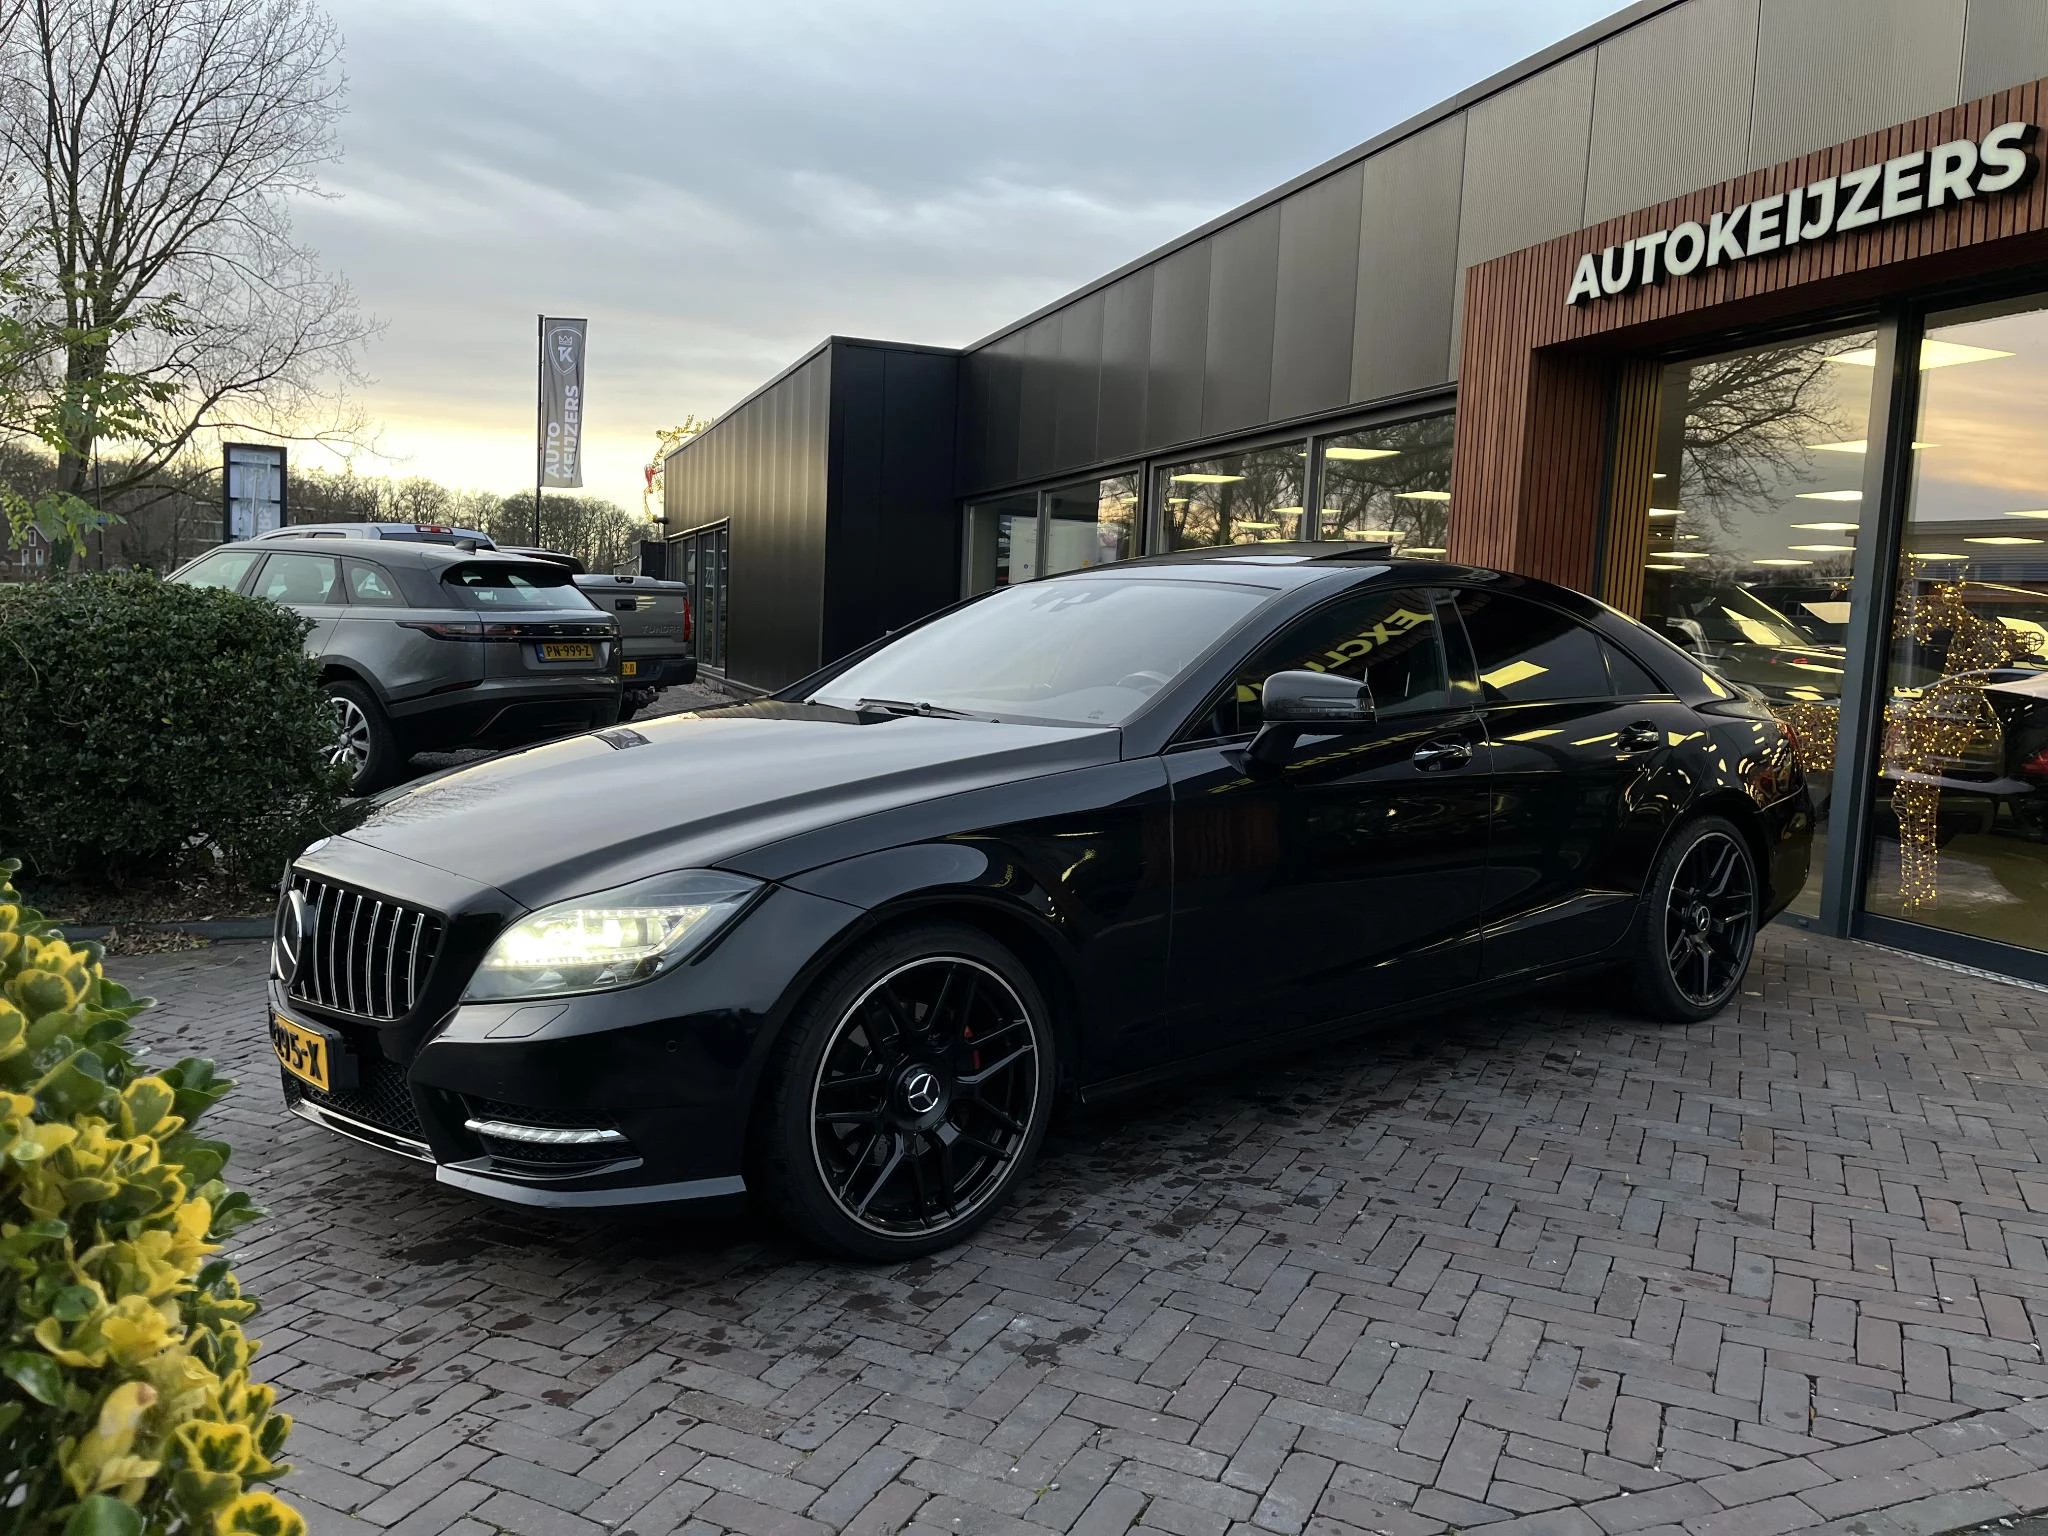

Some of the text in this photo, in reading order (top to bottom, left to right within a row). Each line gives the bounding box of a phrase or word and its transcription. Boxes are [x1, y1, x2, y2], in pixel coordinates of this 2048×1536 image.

[1566, 121, 2031, 306] AUTOKEIJZERS
[545, 422, 561, 478] AUTO
[563, 385, 579, 478] KEIJZERS
[546, 645, 592, 657] PN-999-Z
